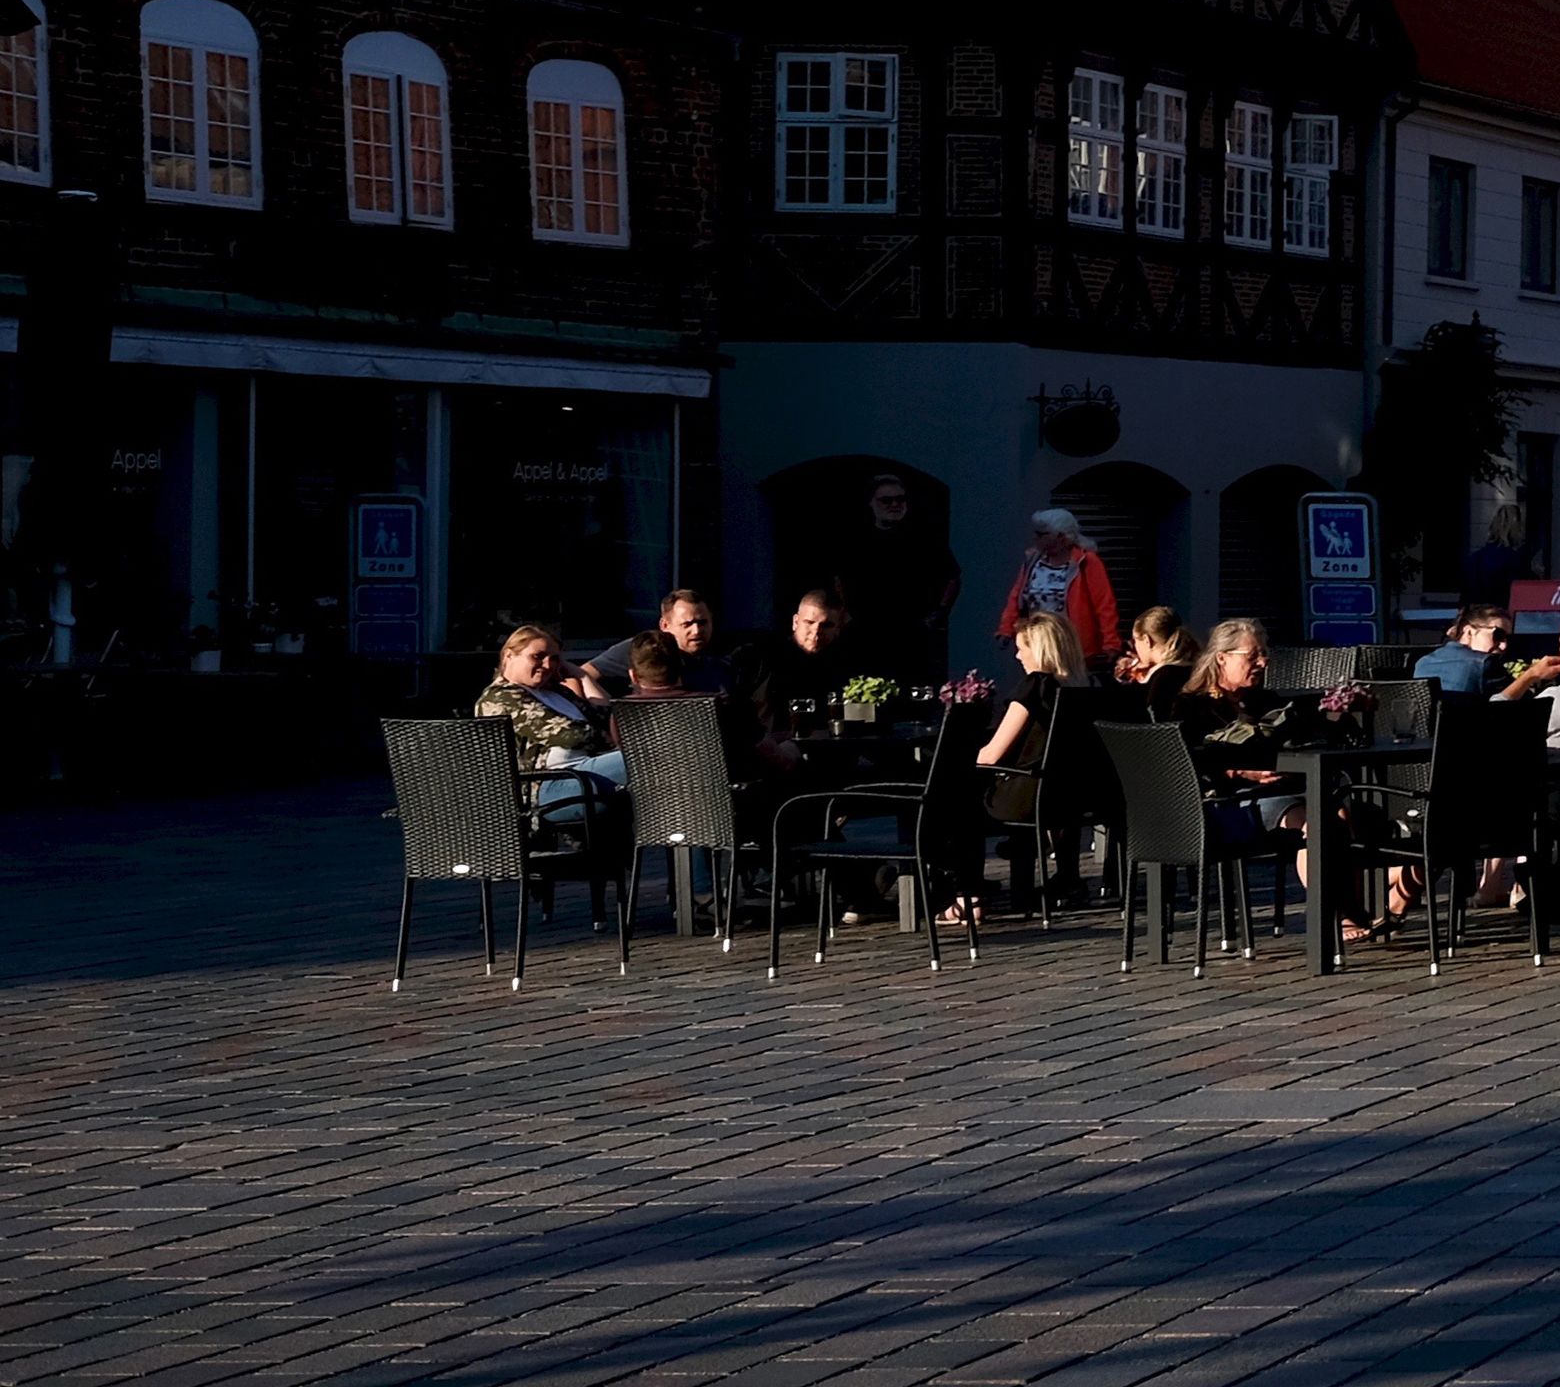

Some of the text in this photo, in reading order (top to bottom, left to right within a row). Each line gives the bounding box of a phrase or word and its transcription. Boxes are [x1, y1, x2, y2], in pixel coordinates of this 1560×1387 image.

[111, 448, 162, 473] Appel
[513, 460, 608, 484] Appel & Appel
[368, 561, 406, 573] Zone
[1322, 560, 1359, 573] Zone
